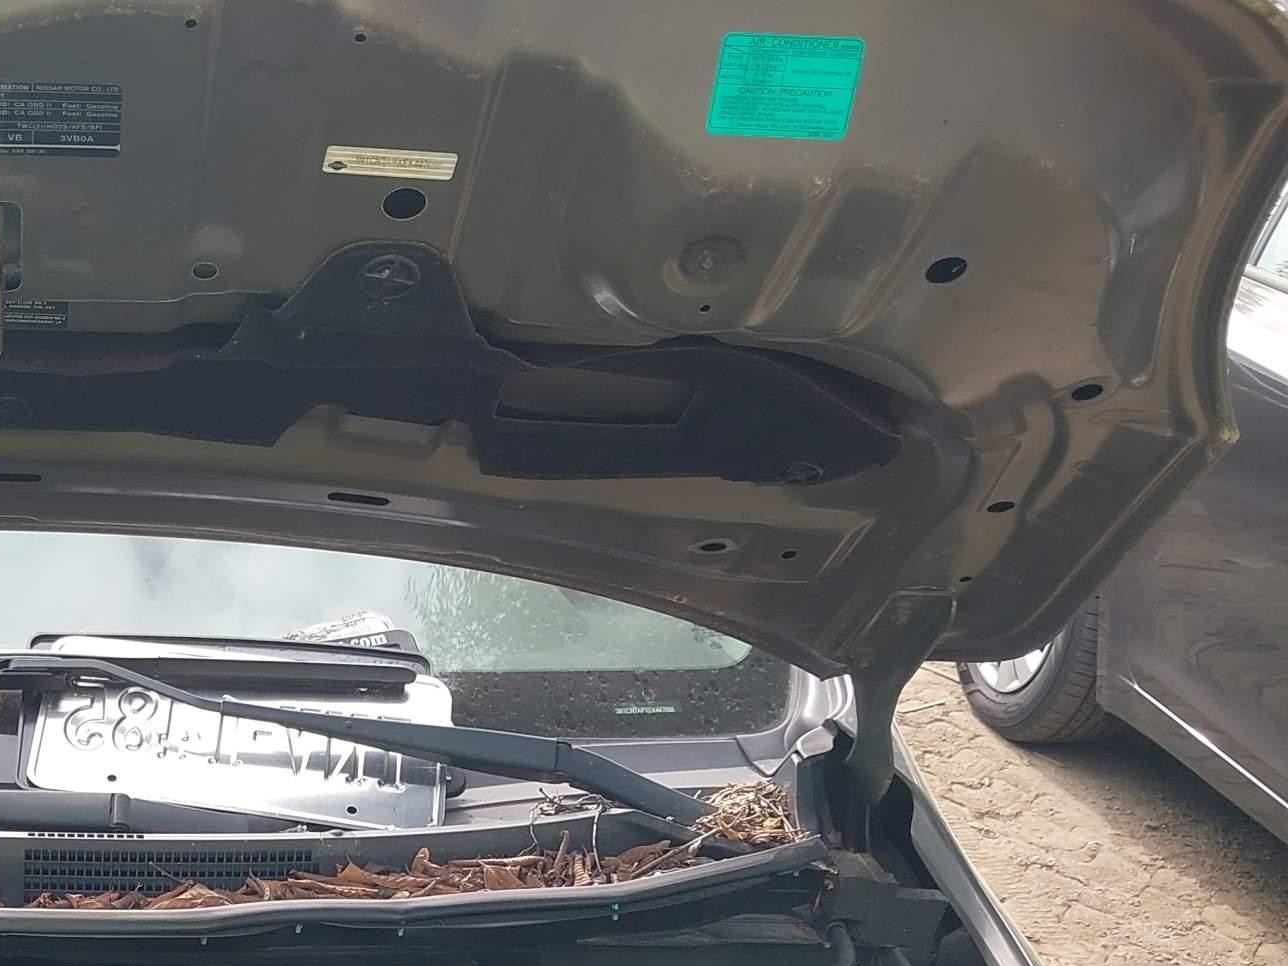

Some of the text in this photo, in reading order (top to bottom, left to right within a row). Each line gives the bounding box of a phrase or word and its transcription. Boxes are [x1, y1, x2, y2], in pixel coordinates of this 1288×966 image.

[749, 38, 766, 46] AIR
[772, 38, 839, 49] CONDITIONER
[780, 89, 832, 97] PRECAUTION
